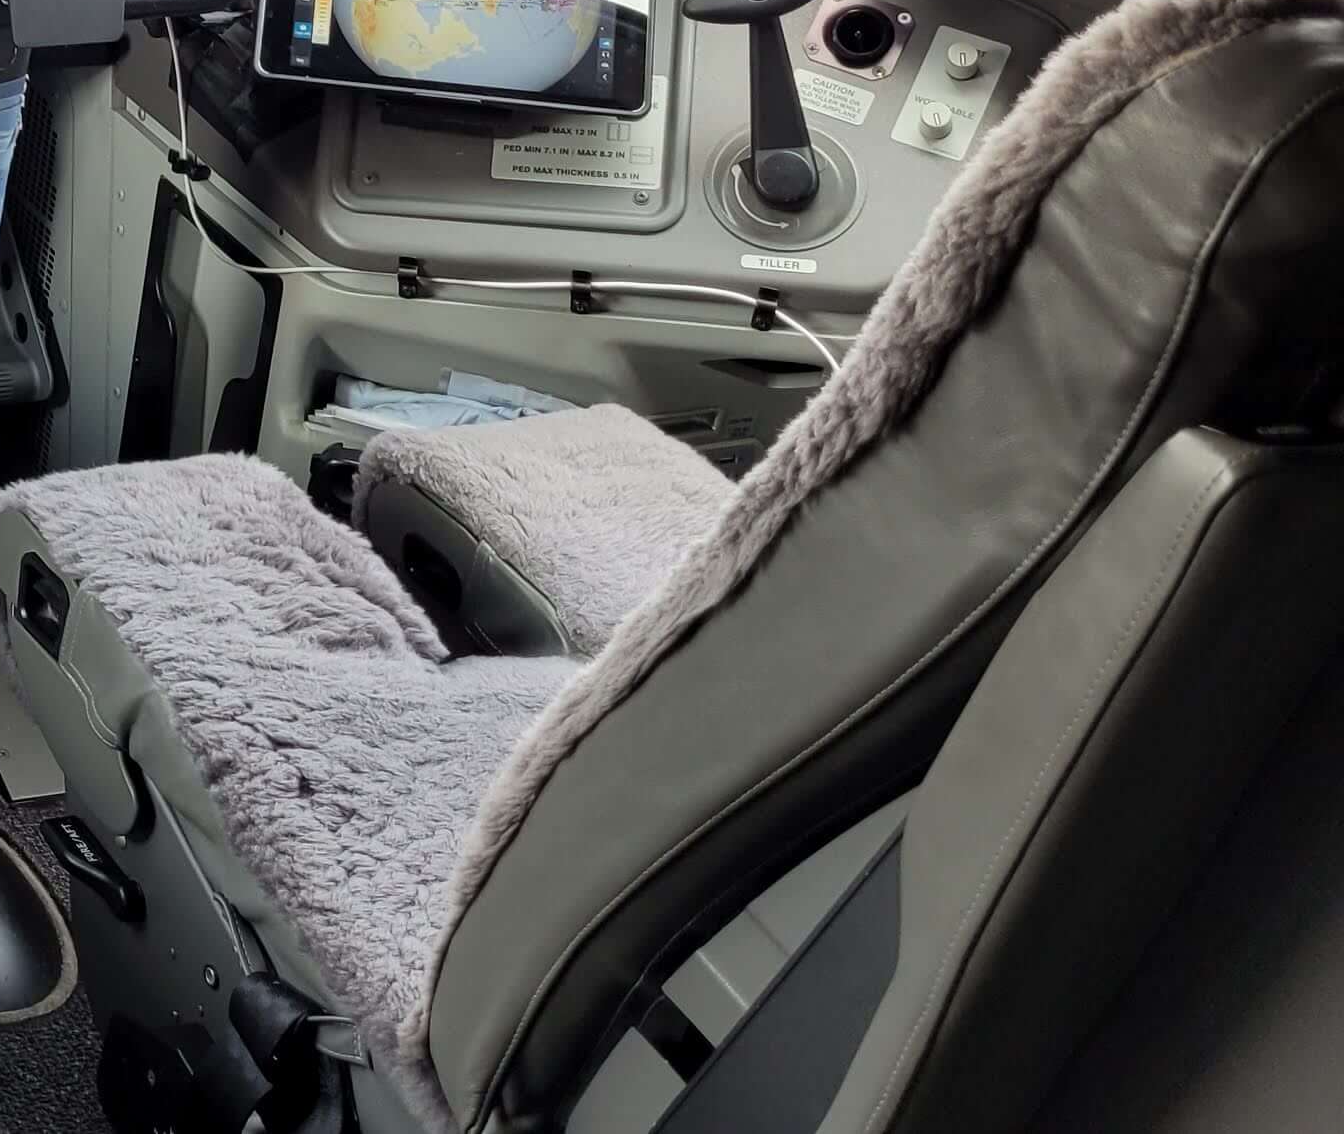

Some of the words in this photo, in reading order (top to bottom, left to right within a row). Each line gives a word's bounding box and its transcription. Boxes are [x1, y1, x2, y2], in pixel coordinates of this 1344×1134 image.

[812, 77, 855, 97] CAUTION
[812, 86, 827, 97] NOT
[828, 90, 848, 102] TURN
[814, 95, 839, 109] TILLER
[840, 101, 862, 114] WHILE
[552, 127, 572, 135] MAX
[503, 144, 522, 152] PED
[524, 145, 541, 153] MIN
[577, 149, 597, 157] MAX
[512, 165, 531, 173] PED
[533, 166, 553, 175] MAX
[556, 168, 609, 178] THICKNESS
[630, 172, 640, 180] IN
[759, 258, 801, 271] TILLER
